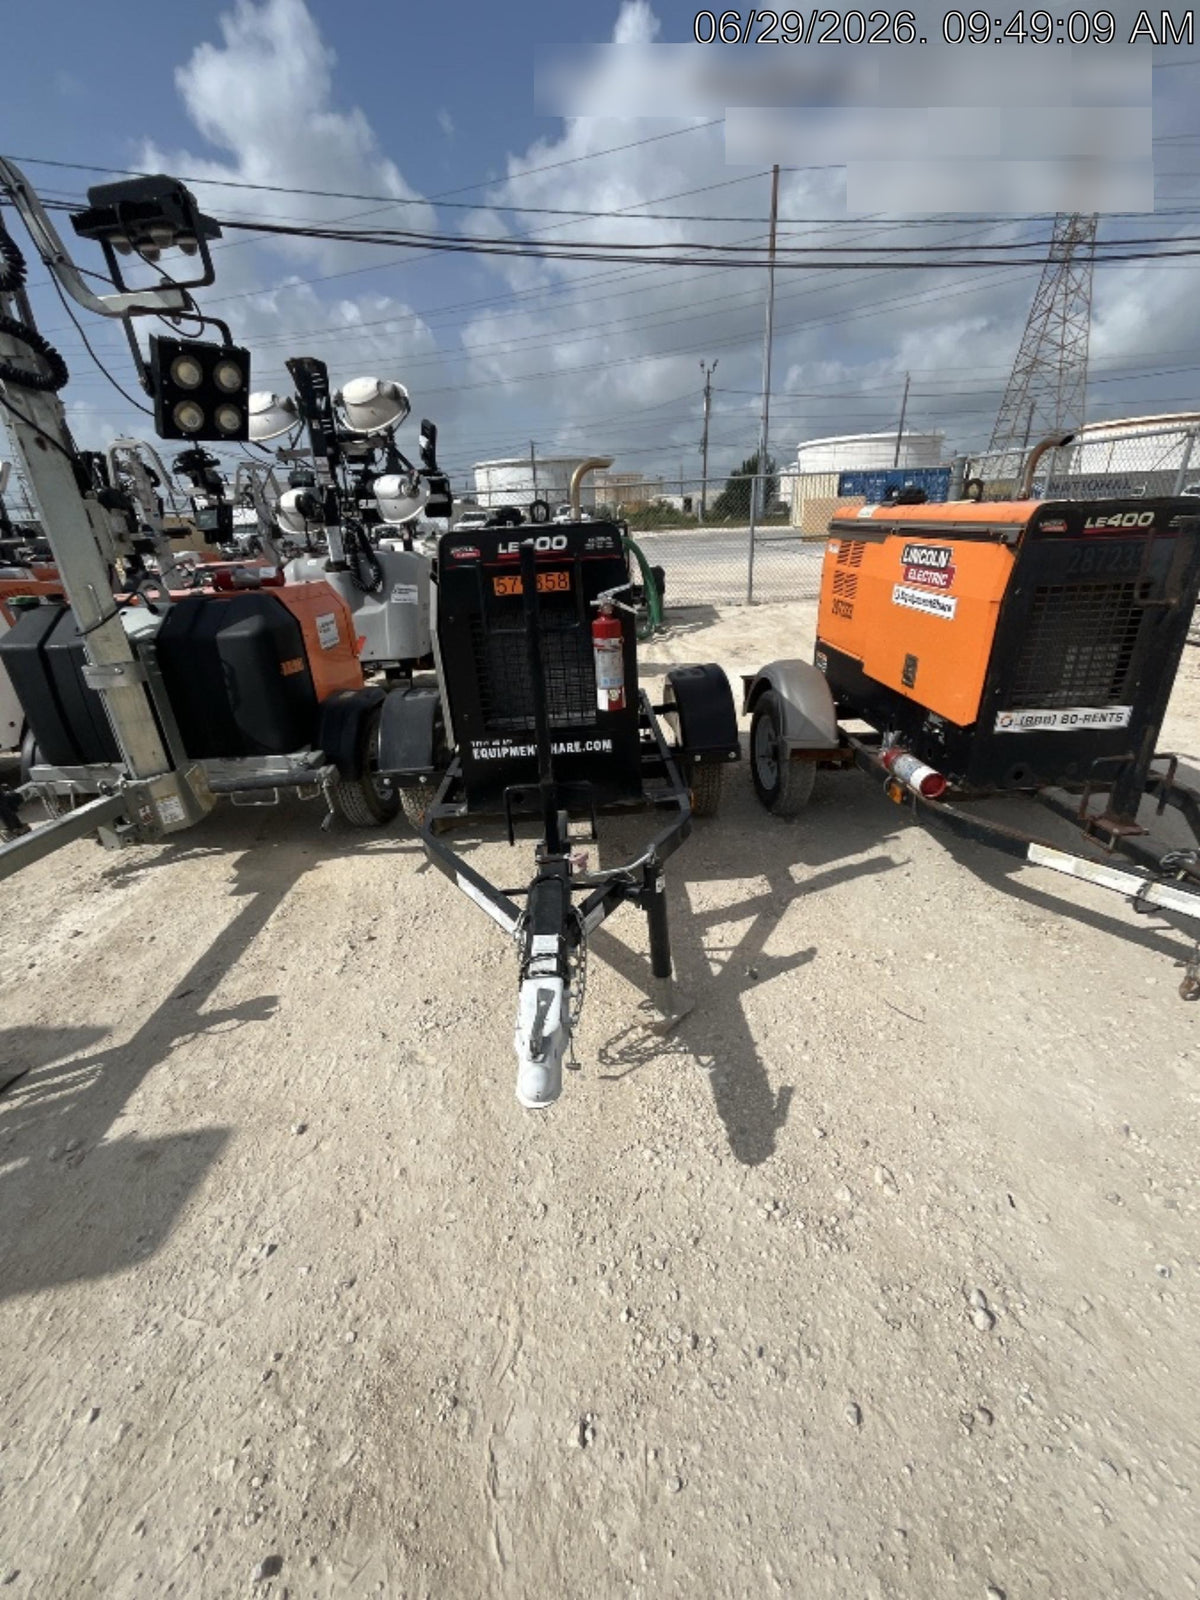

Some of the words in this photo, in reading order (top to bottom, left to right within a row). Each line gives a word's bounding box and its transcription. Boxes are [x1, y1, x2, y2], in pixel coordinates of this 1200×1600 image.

[1084, 511, 1155, 529] LE400
[903, 546, 949, 568] LINCOLN
[907, 568, 949, 585] ELECTRIC
[471, 739, 612, 760] EQUIPMENHARE.COM
